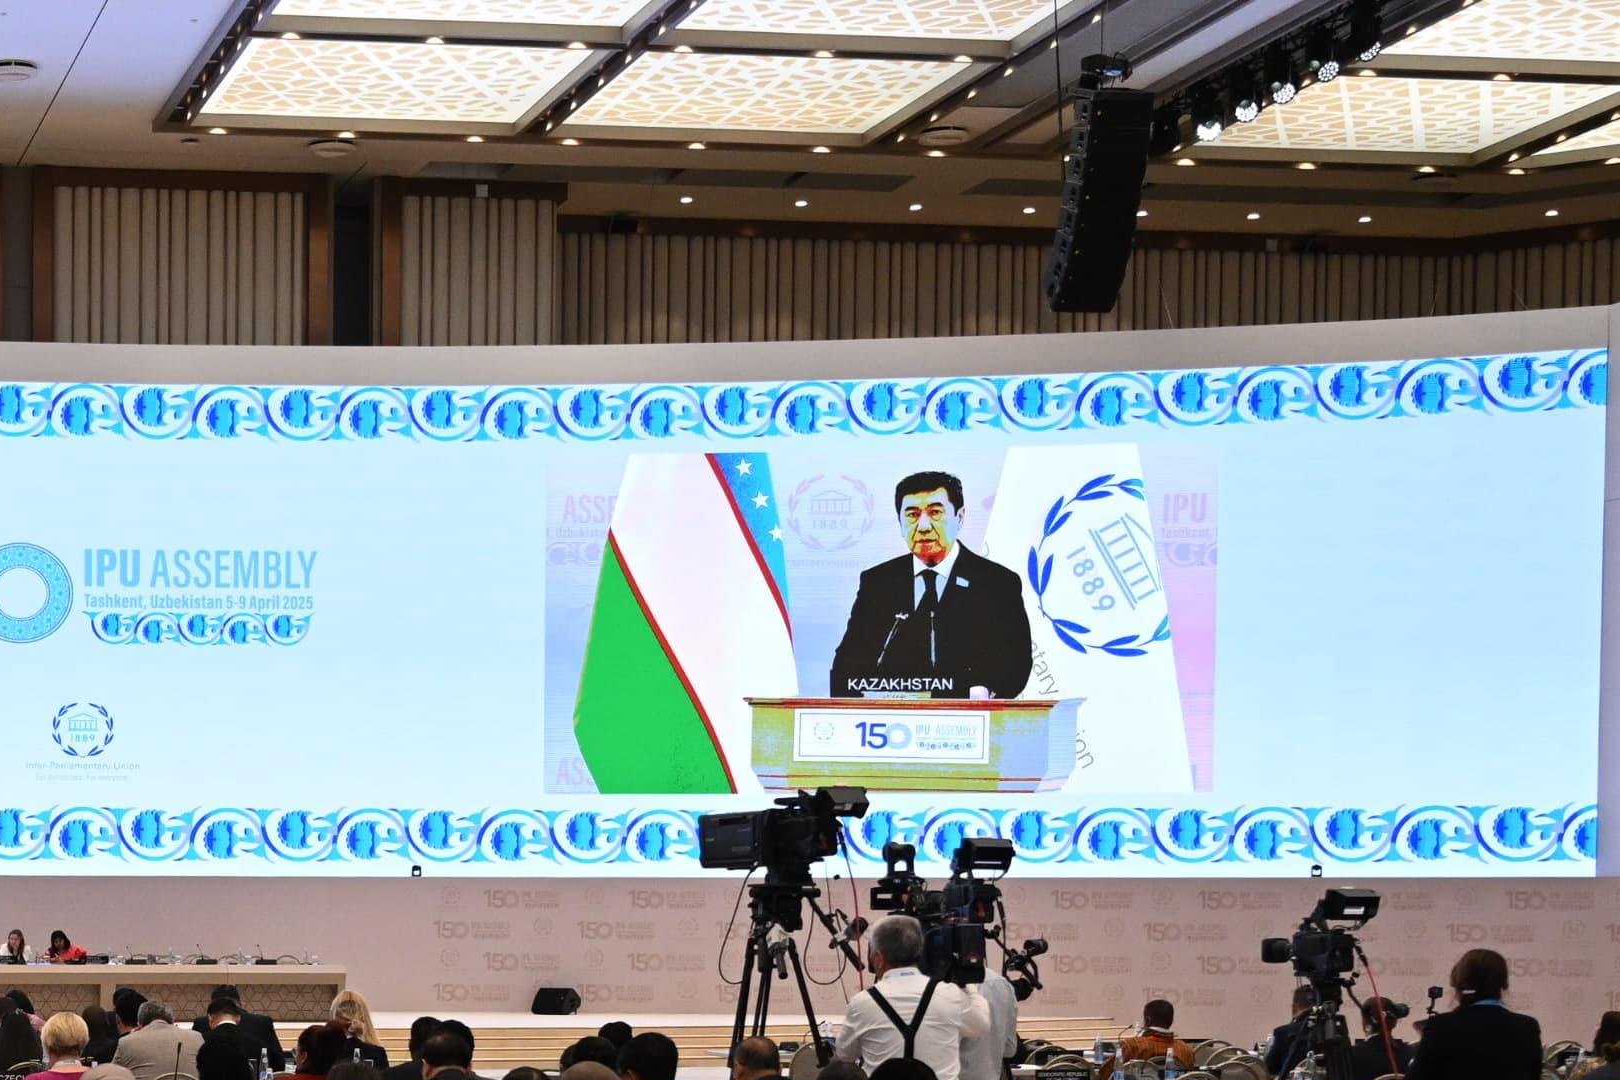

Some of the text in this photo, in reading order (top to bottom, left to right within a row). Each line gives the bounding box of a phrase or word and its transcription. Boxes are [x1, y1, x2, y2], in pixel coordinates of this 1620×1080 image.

[1163, 492, 1208, 524] IPU
[83, 548, 318, 589] IPU ASSEMBLY
[1067, 545, 1116, 611] 1889
[83, 593, 314, 612] Tashkent, Uzbekistan 5-9 April 2025
[847, 678, 953, 690] KAZAKHSTAN
[855, 721, 912, 749] 150
[484, 889, 519, 908] 150
[628, 890, 664, 909] 150
[1051, 889, 1089, 910] 150
[1198, 890, 1237, 910] 150
[434, 921, 469, 939] 150
[578, 921, 613, 940] 150
[1144, 923, 1181, 942] 150
[1446, 923, 1486, 943] 150
[483, 952, 518, 971] 150
[628, 953, 663, 972] 150
[1051, 955, 1088, 974] 150
[1197, 956, 1236, 975] 150
[433, 984, 468, 1002] 150
